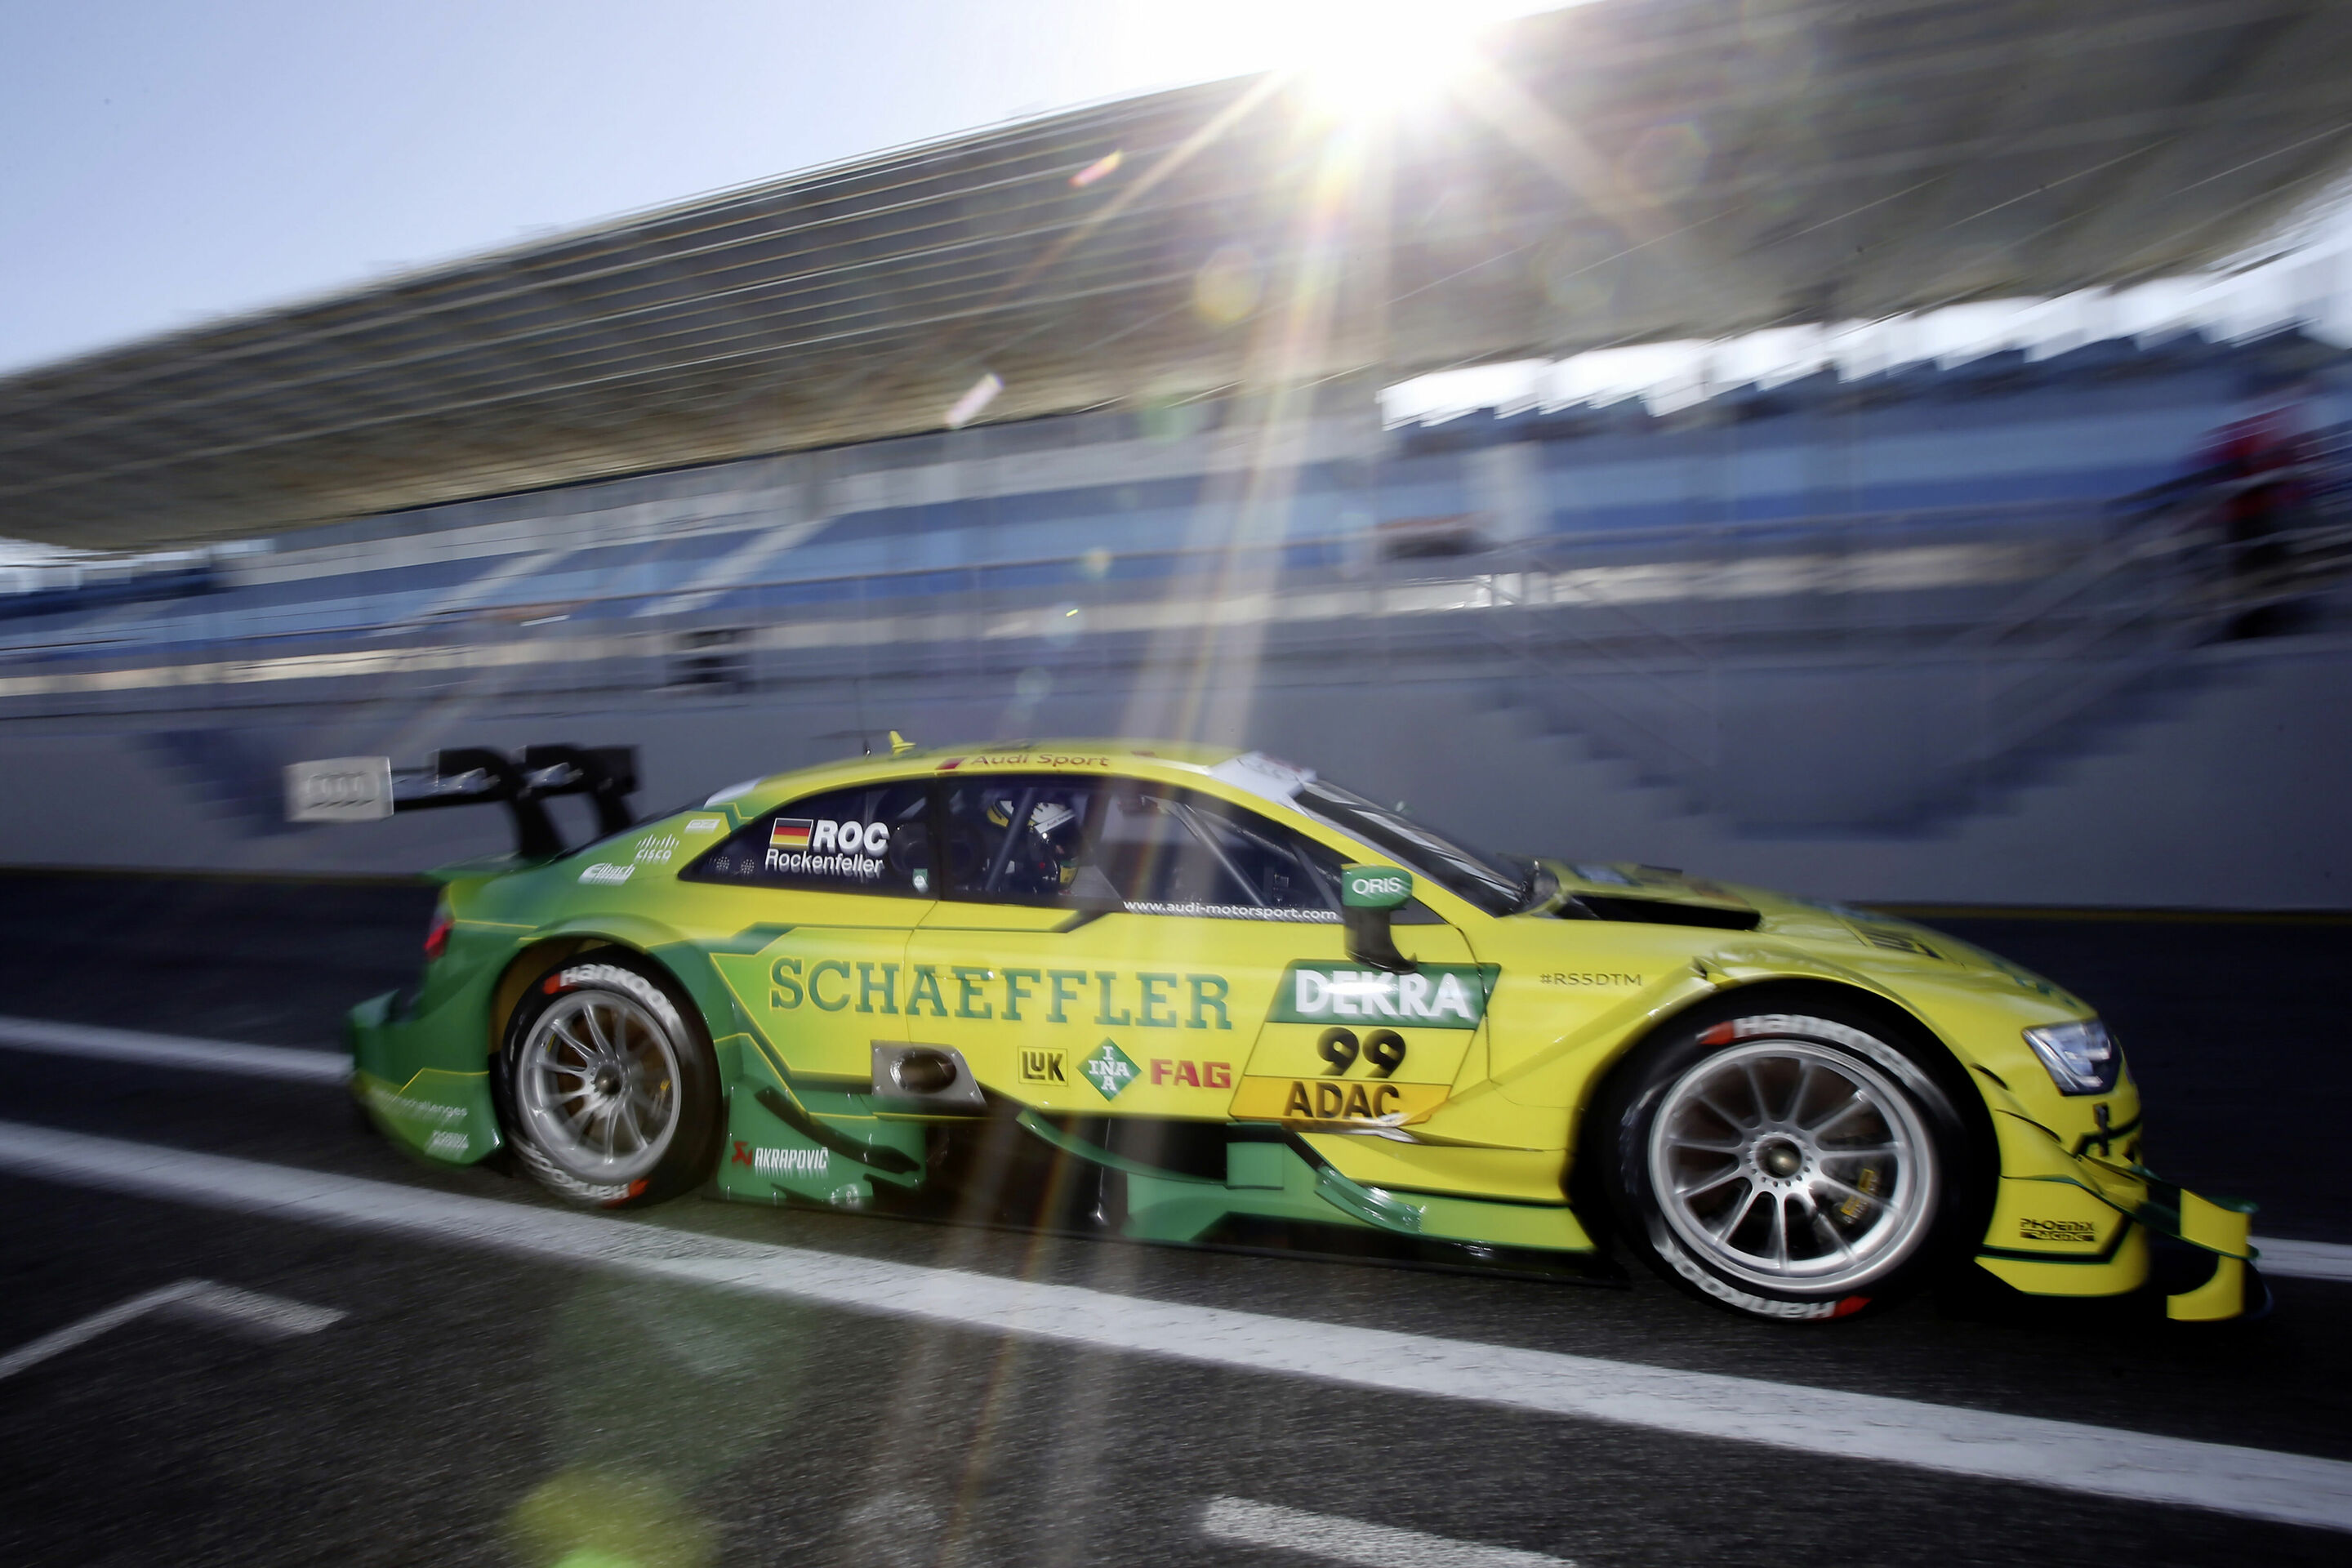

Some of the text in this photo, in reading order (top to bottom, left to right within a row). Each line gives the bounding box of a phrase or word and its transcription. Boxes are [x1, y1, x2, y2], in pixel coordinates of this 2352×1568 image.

[971, 754, 1110, 767] Audi Sport
[813, 819, 891, 857] ROC
[765, 848, 884, 882] Rockenfeller
[1352, 876, 1401, 894] ORIS
[1123, 900, 1338, 921] www.audi-motorsport.com
[771, 957, 1232, 1030] SCHAEFFLER
[1295, 969, 1471, 1018] DEKRA
[1539, 973, 1642, 987] #RS5DTM
[1088, 1059, 1130, 1077] INA
[1316, 1027, 1406, 1079] 99
[1150, 1058, 1232, 1089] FAG
[1283, 1080, 1400, 1119] ADAC
